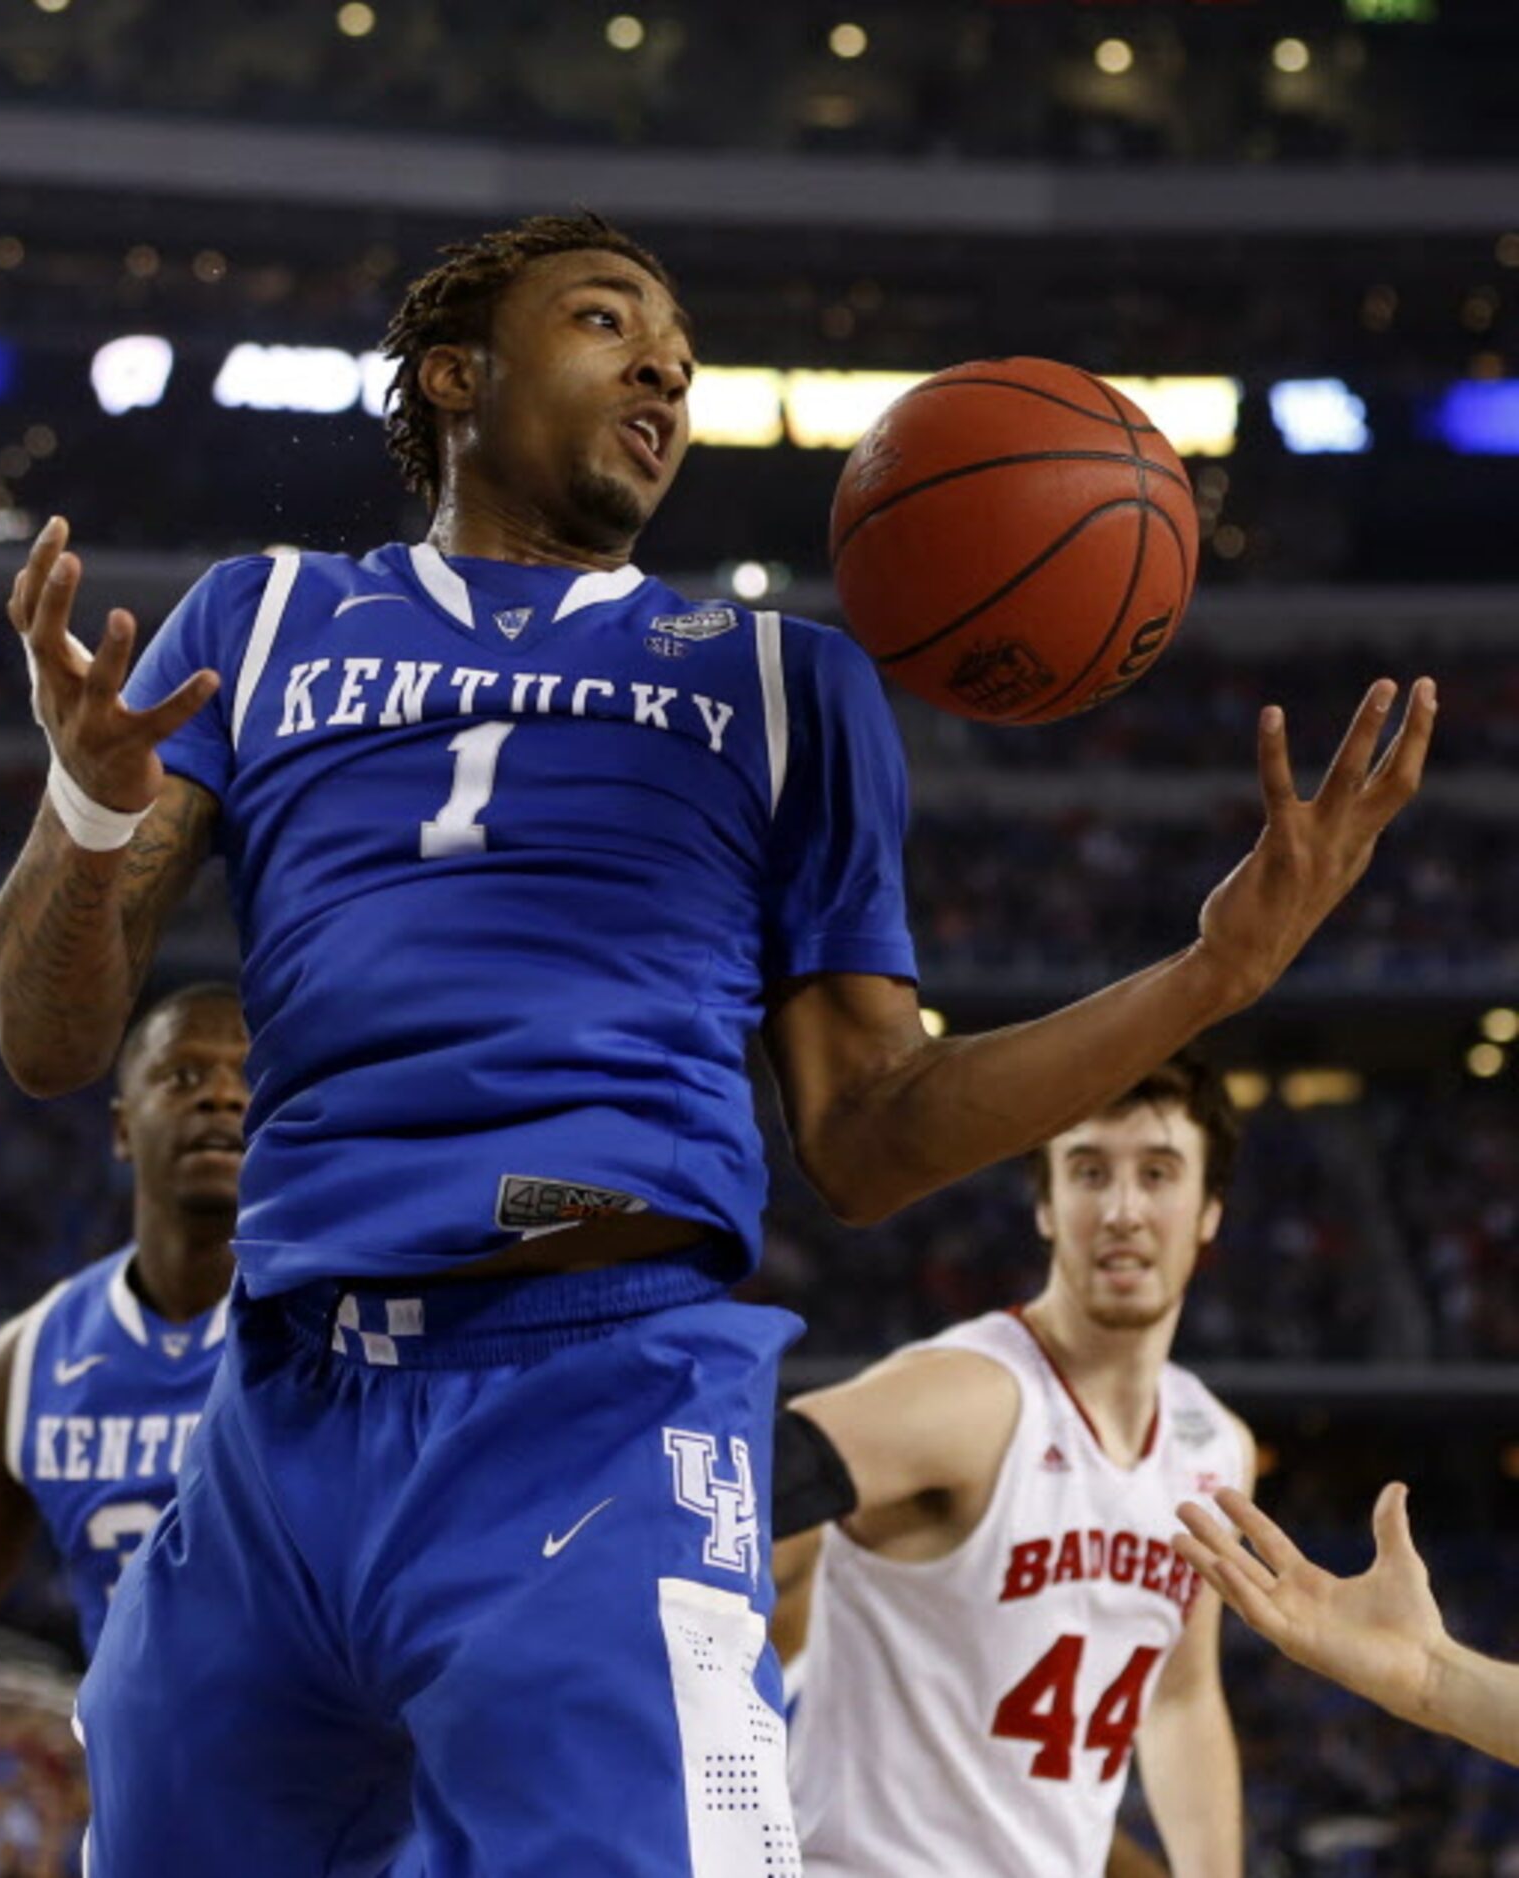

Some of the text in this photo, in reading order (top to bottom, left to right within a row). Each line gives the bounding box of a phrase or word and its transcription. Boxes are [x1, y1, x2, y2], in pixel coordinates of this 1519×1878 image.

[276, 657, 734, 752] KENTUCKY
[420, 721, 515, 859] 1
[990, 1634, 1164, 1783] 44
